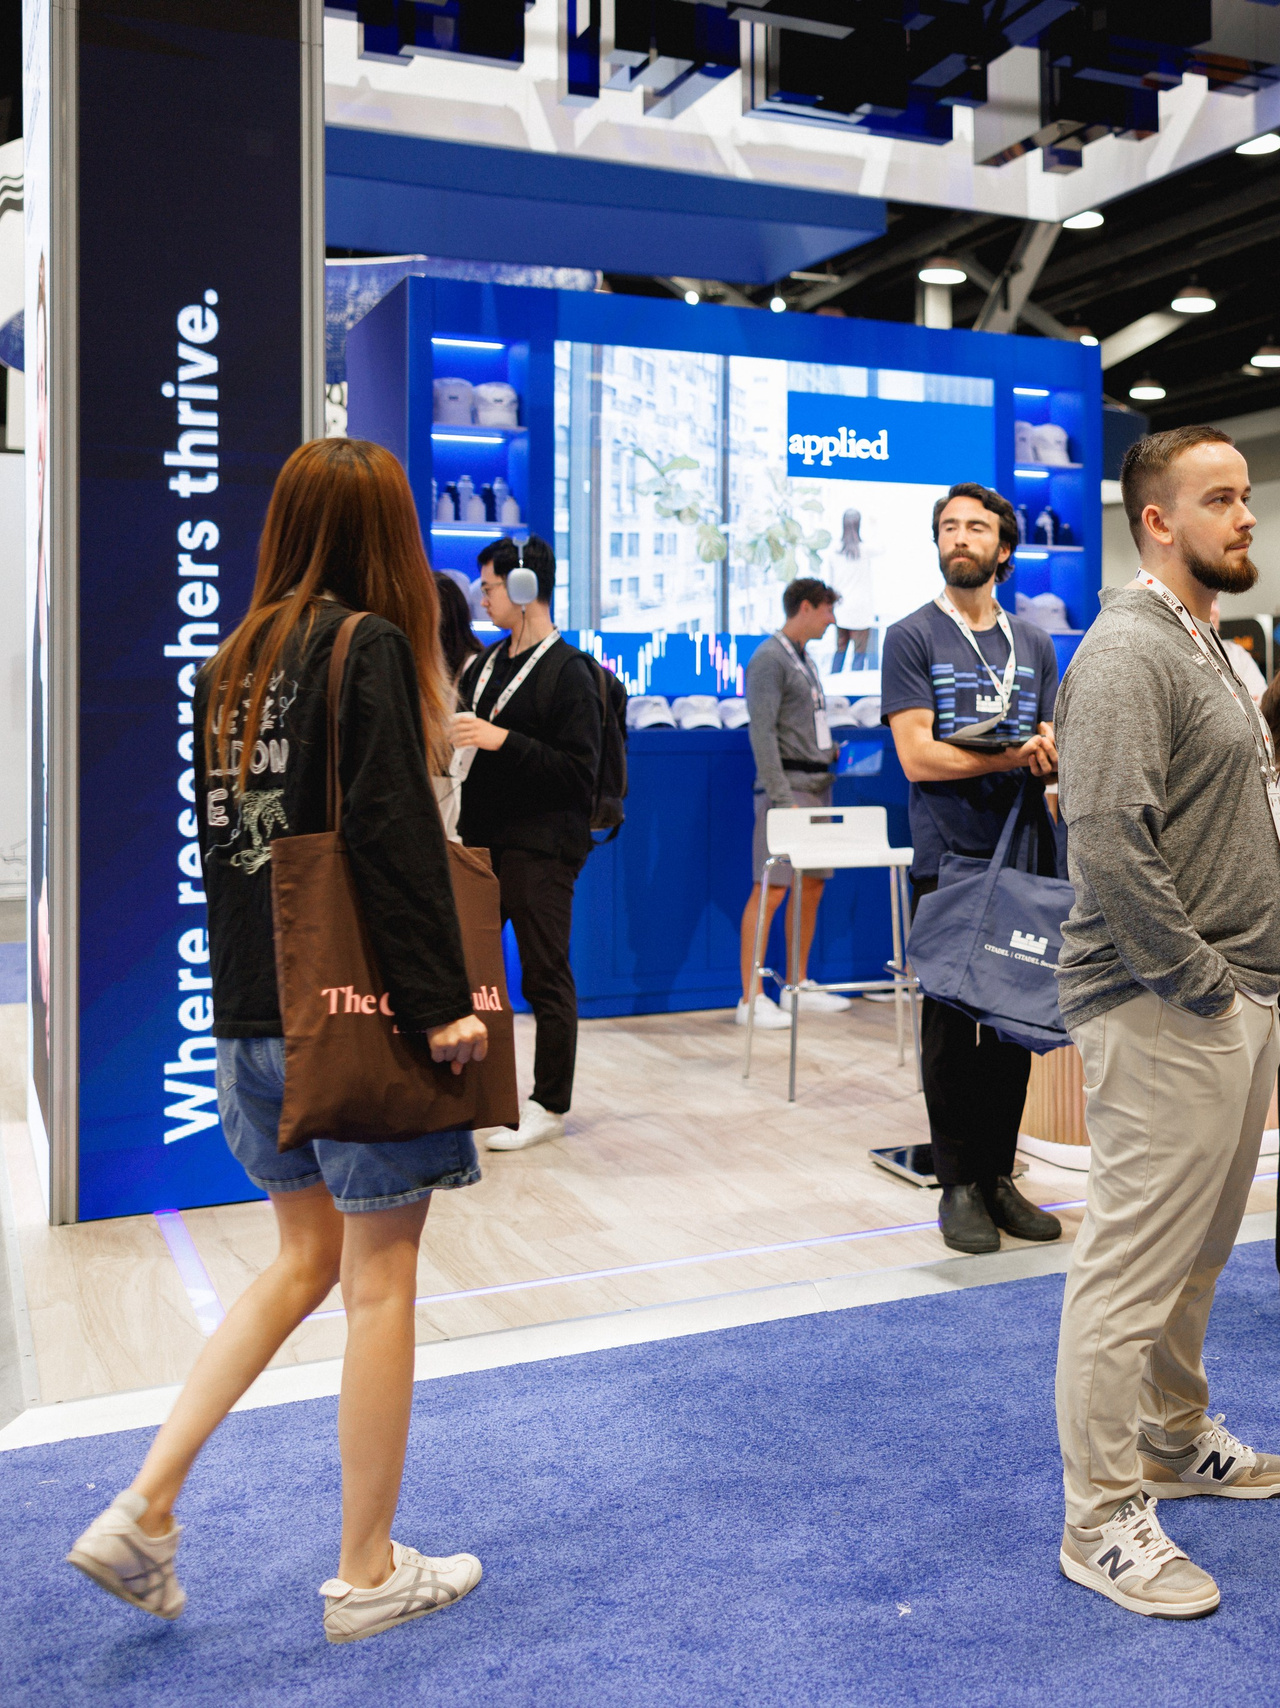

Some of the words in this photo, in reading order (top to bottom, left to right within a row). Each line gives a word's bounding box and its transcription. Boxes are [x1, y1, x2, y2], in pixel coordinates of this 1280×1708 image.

[161, 288, 219, 498] thrive.
[788, 426, 889, 466] applied
[984, 943, 1009, 957] CITADEL
[1014, 952, 1040, 966] CITADEL
[320, 985, 378, 1015] The
[163, 927, 220, 1145] Where
[1196, 1450, 1236, 1481] N
[1097, 1545, 1135, 1581] N
